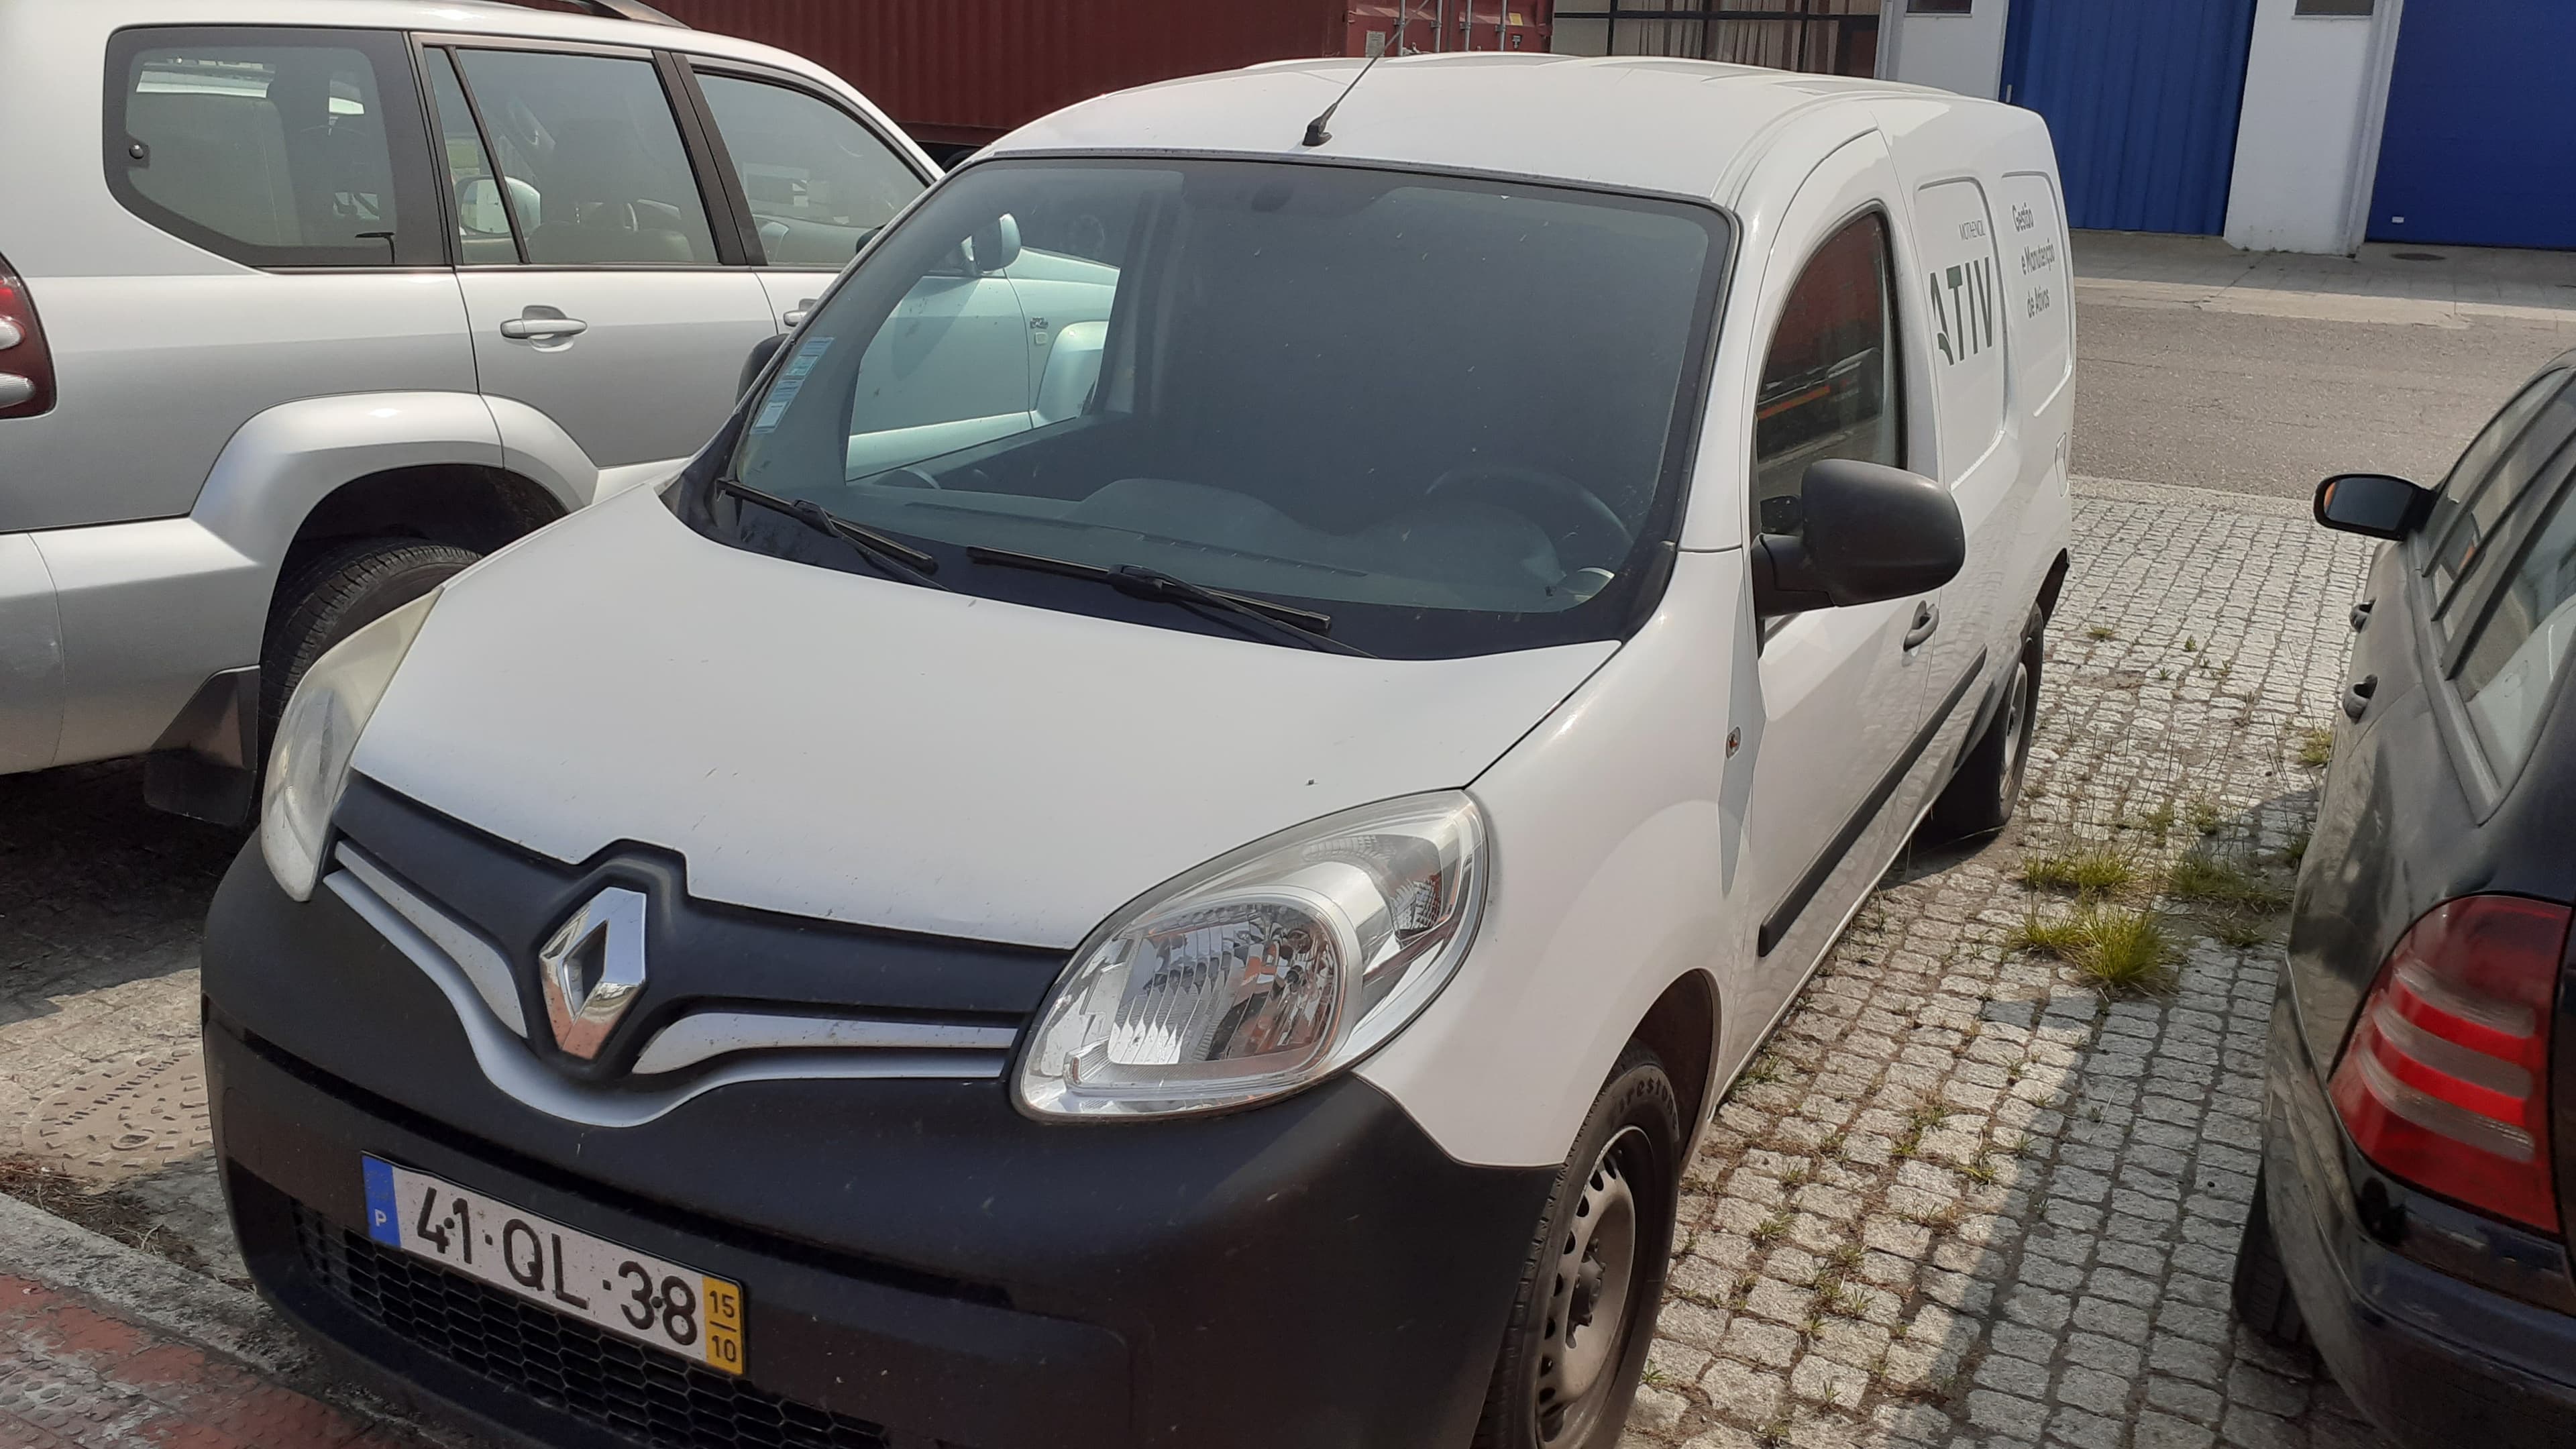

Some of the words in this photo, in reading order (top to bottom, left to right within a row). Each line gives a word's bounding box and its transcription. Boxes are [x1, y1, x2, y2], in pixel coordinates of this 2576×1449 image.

[2012, 202, 2034, 232] Gestão
[2021, 255, 2027, 275] e
[1929, 256, 1992, 366] ATIV
[2027, 290, 2035, 319] de
[2035, 284, 2050, 315] Ativos
[374, 1208, 387, 1227] P
[708, 1289, 735, 1319] 15
[711, 1334, 737, 1363] 10
